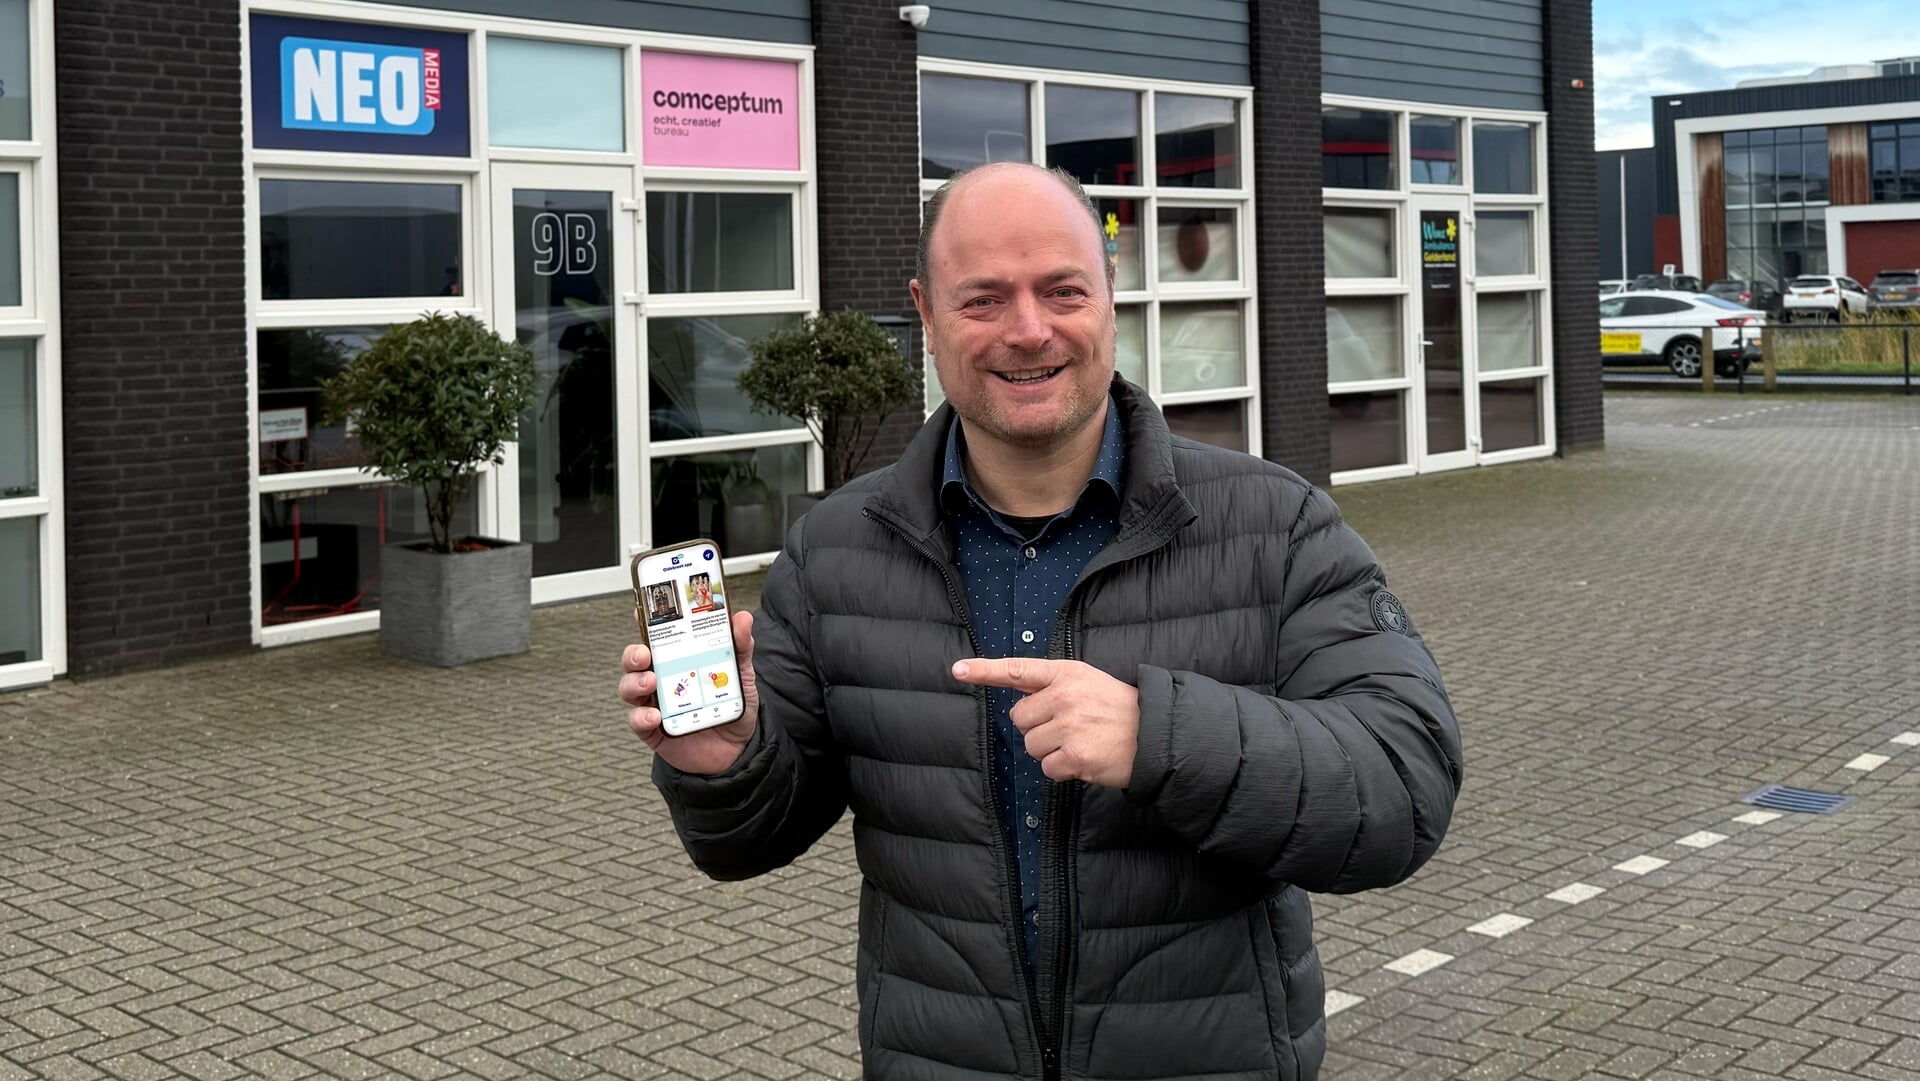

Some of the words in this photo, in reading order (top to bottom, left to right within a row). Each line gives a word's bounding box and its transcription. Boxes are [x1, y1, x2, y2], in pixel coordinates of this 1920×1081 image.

[293, 47, 420, 127] NEO
[425, 51, 438, 107] MEDIA
[653, 89, 784, 116] comceptum
[653, 115, 680, 128] echt,
[682, 116, 723, 128] creatief
[653, 126, 690, 138] bureau
[531, 212, 597, 276] 9B
